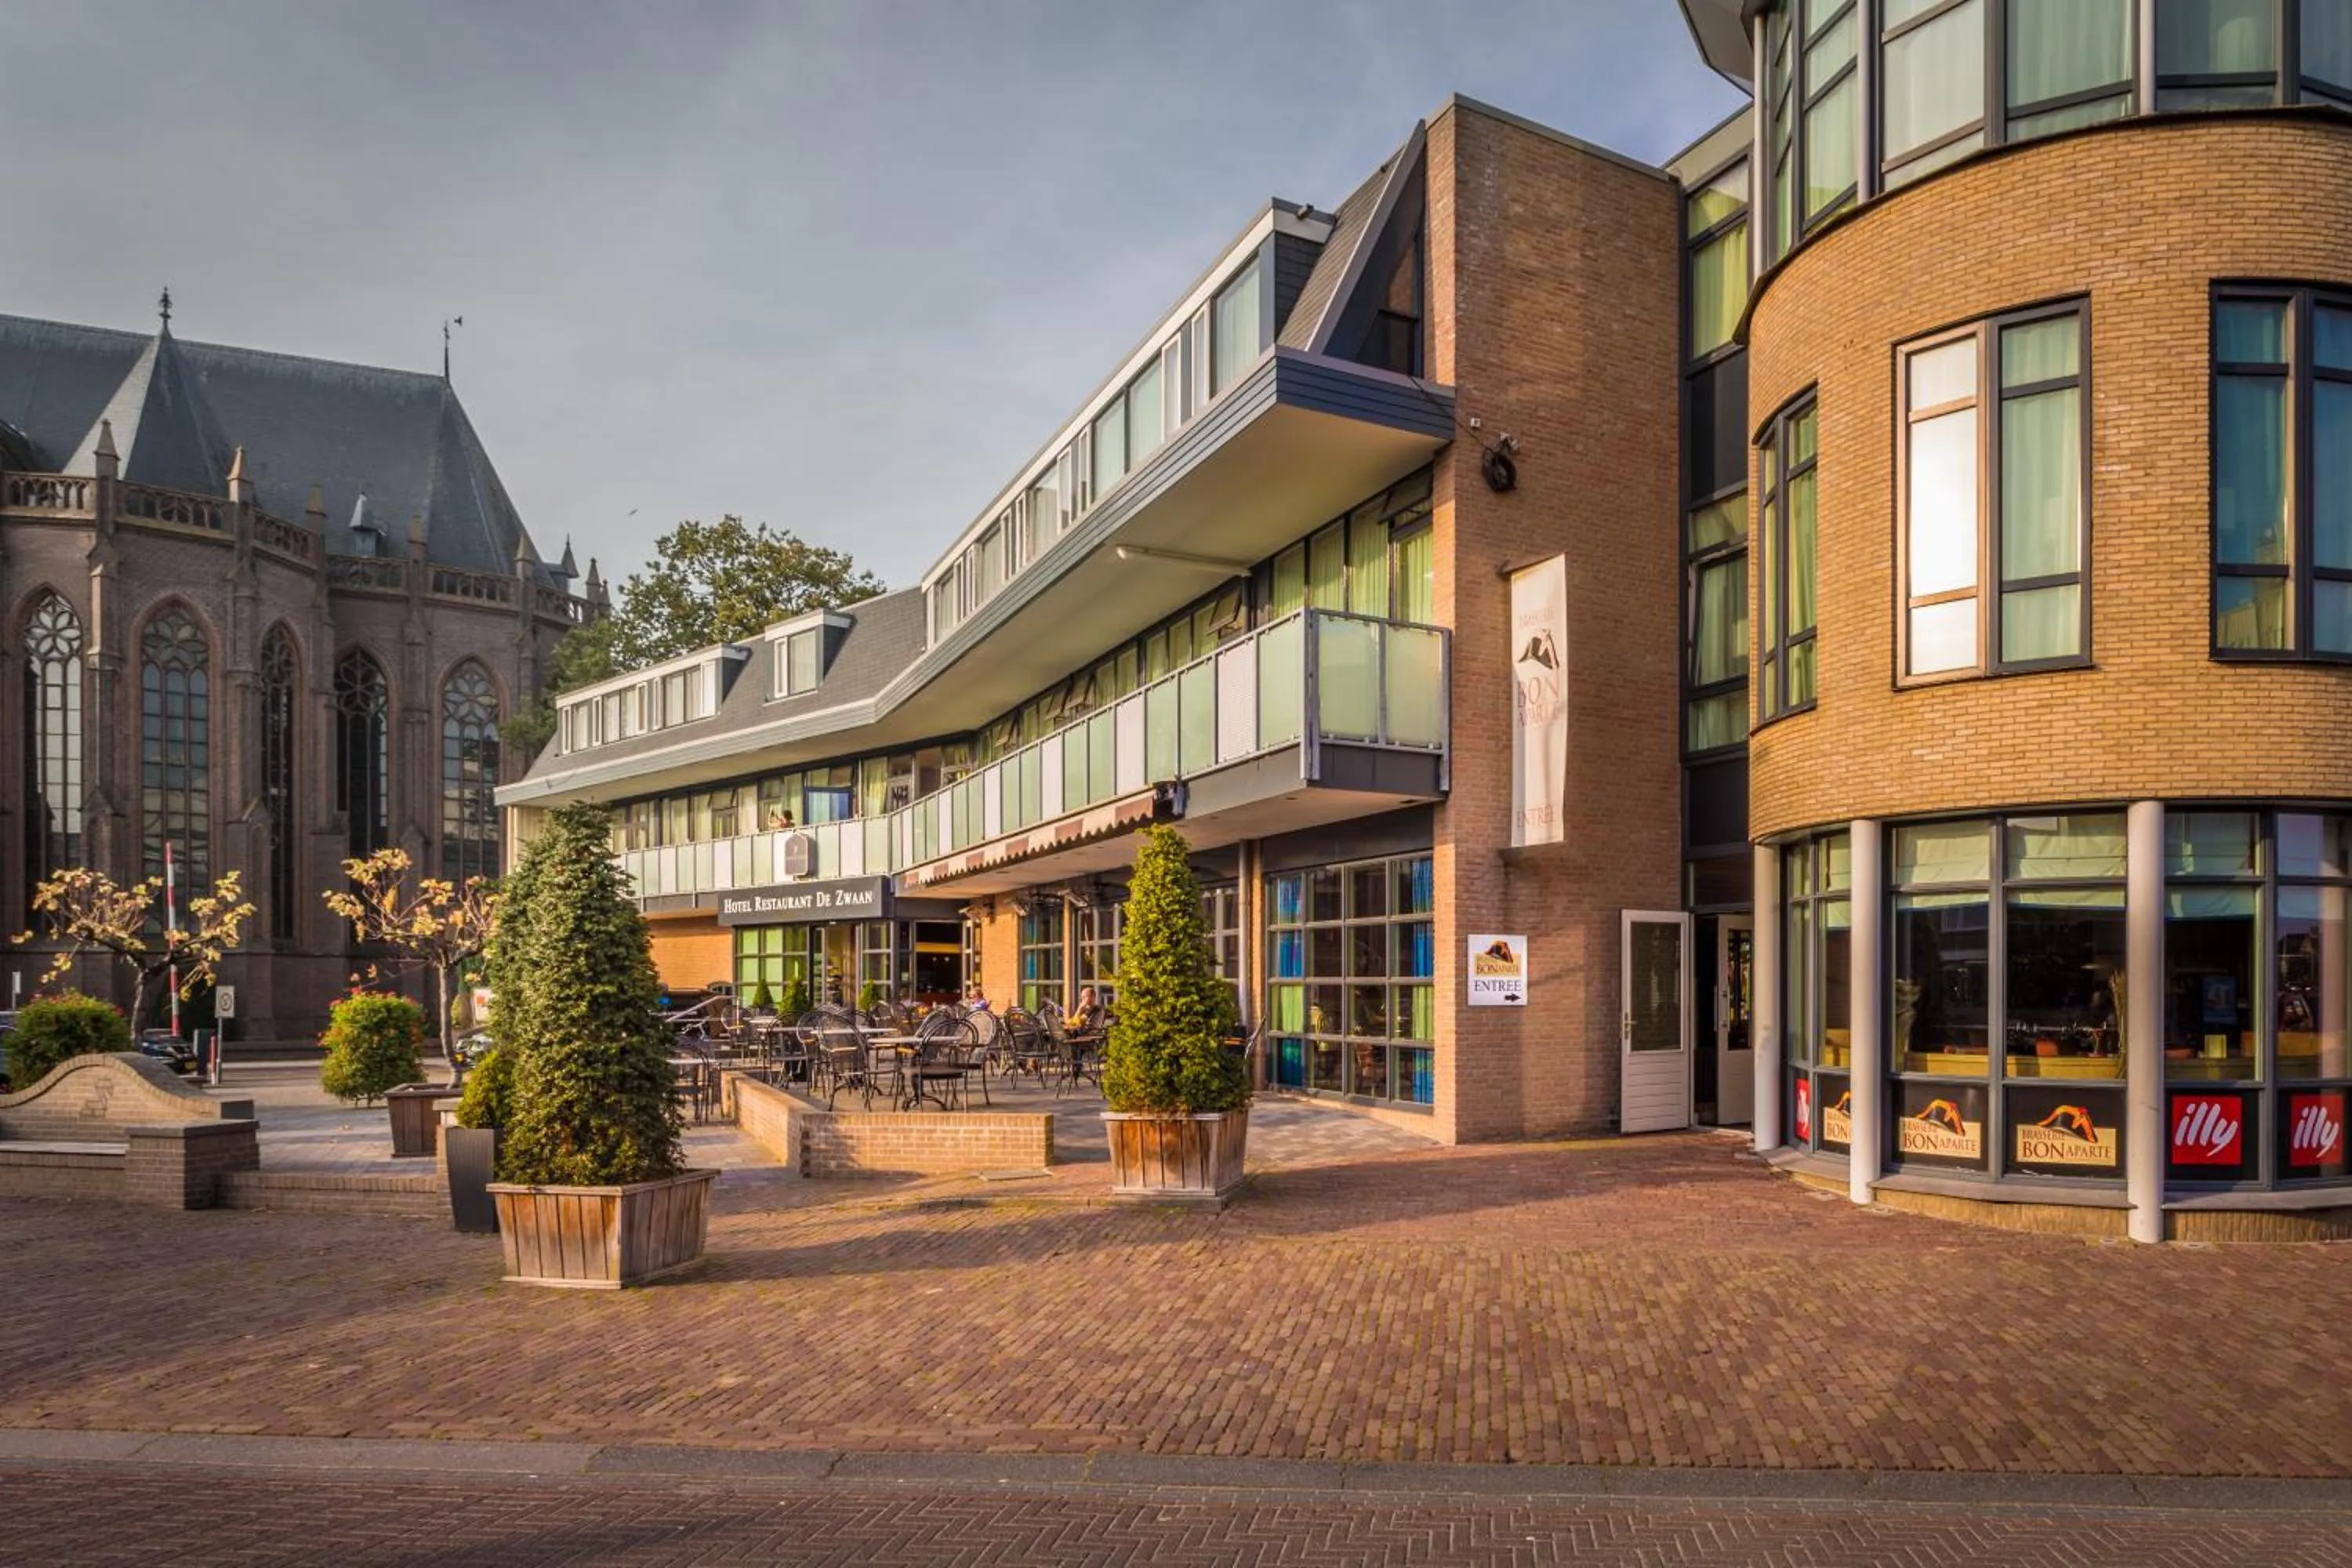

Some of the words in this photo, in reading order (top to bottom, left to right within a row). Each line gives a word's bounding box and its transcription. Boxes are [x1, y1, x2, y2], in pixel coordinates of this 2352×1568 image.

[1475, 979, 1522, 992] ENTREE
[2023, 1128, 2066, 1140] BRASSERIE
[2174, 1102, 2238, 1157] illy
[2293, 1105, 2339, 1158] illy
[1904, 1133, 1976, 1152] BONAPARTE
[2023, 1141, 2111, 1159] BONAPARTE
